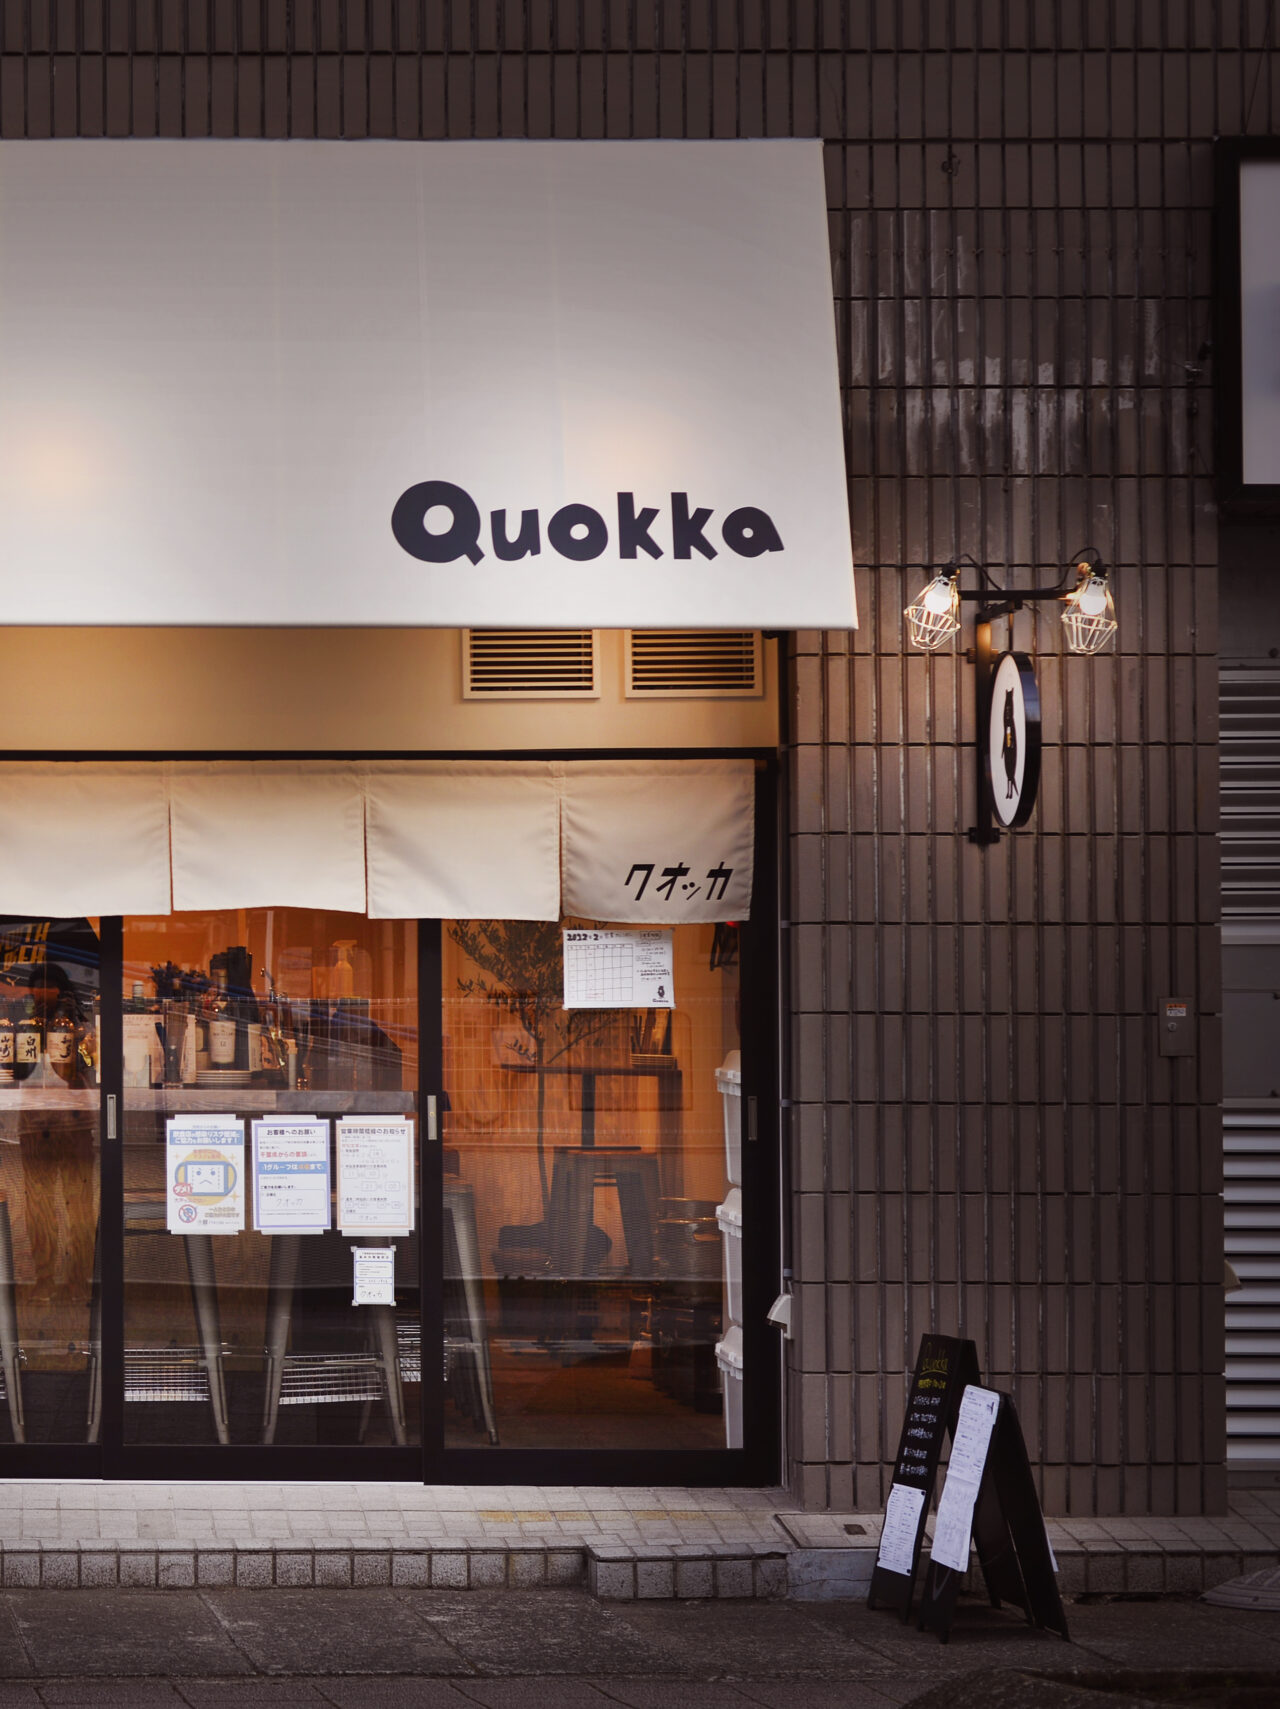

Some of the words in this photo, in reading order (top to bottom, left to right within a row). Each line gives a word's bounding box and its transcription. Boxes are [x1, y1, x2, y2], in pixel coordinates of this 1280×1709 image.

[391, 480, 785, 566] Quokka
[624, 861, 734, 901] クオッカ
[25, 1036, 37, 1059] 白州
